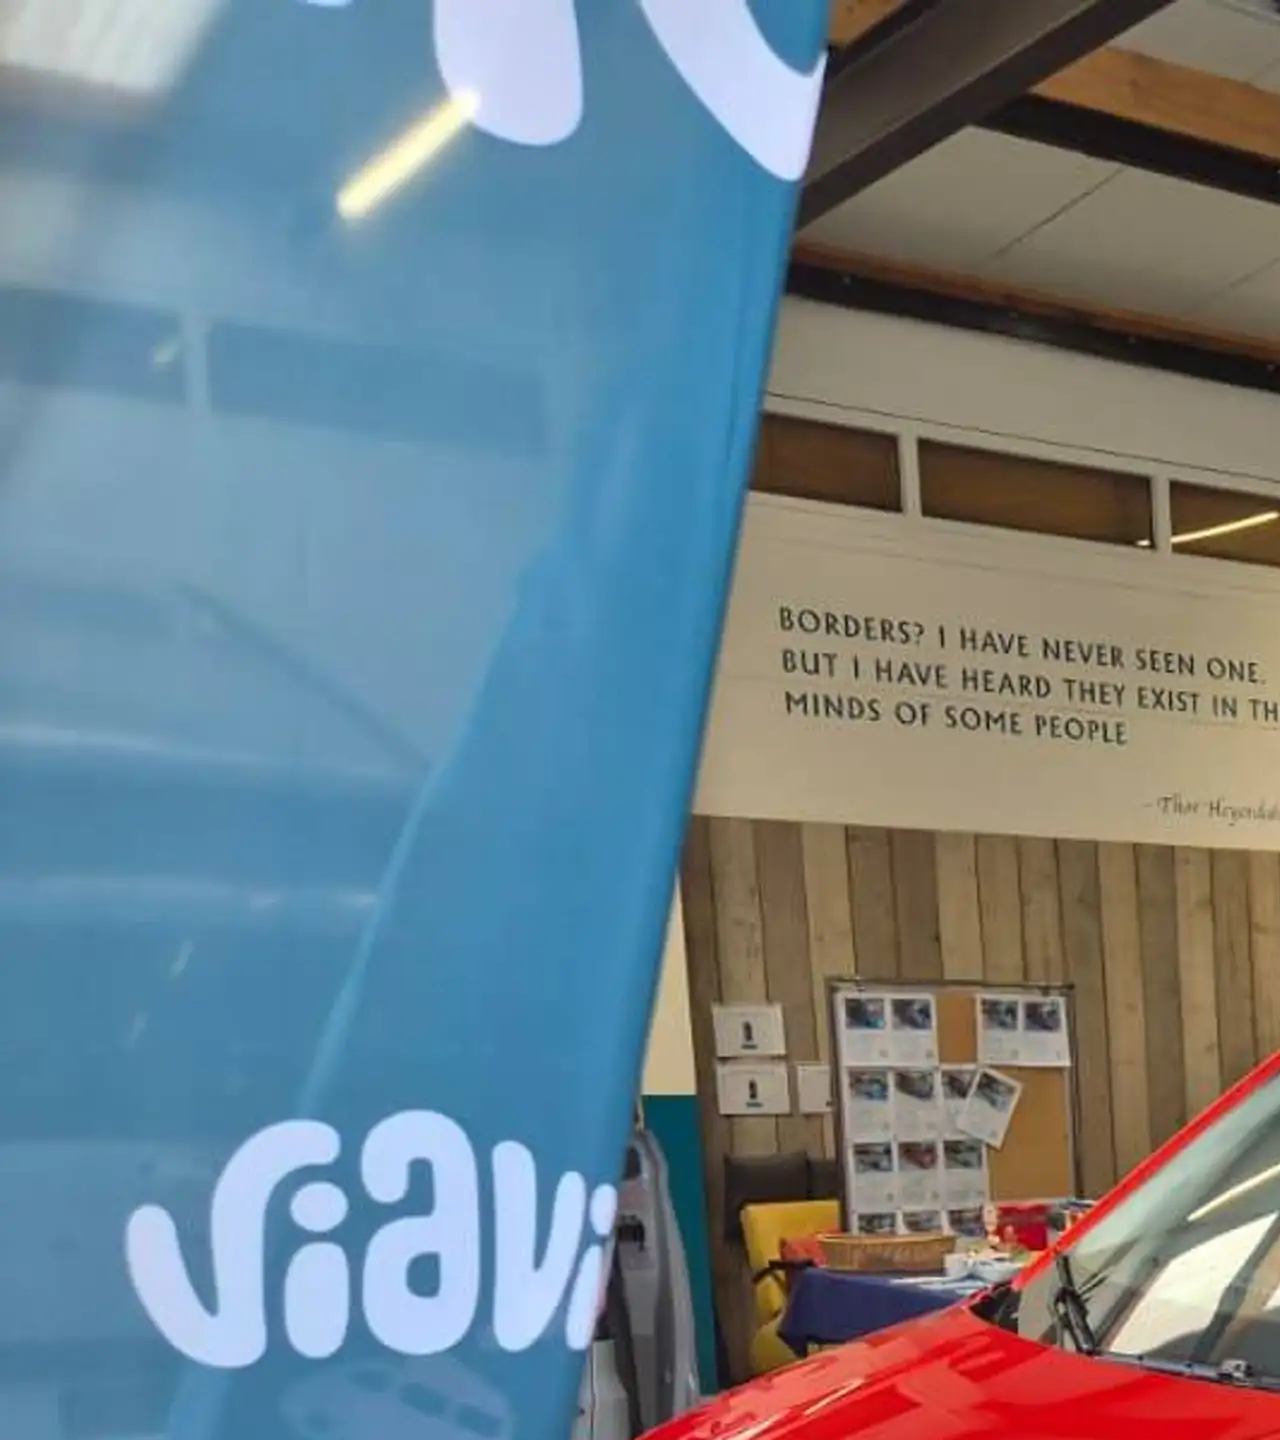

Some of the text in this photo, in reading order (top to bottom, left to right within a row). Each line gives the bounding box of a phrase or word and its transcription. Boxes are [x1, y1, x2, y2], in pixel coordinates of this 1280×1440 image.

[779, 606, 1267, 685] BORDERS? I HAVE NEVER SEEN ONE.
[782, 649, 838, 678] BUT
[853, 655, 860, 681] I
[875, 657, 948, 689] HAVE
[961, 667, 1053, 699] HEARD
[1063, 678, 1126, 708] THEY
[1137, 685, 1200, 715] EXIST
[1212, 695, 1238, 720] IN
[784, 691, 1128, 744] MINDS OF SOME PEOPLE
